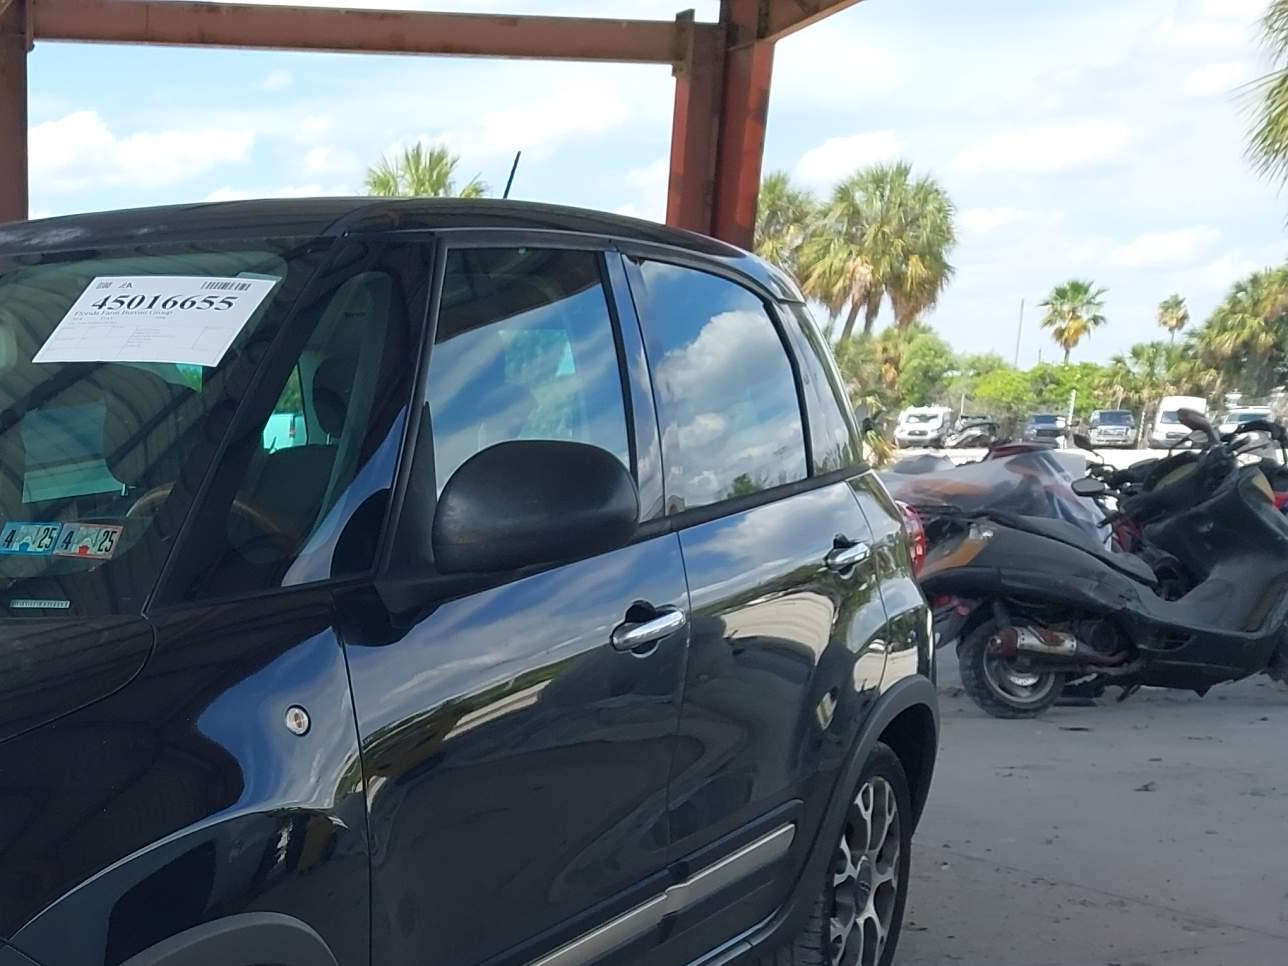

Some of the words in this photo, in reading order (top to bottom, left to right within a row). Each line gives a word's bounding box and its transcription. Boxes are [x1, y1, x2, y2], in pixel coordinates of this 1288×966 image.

[91, 294, 239, 311] 45016655
[2, 530, 16, 549] 4
[37, 527, 57, 549] 25
[62, 530, 75, 550] 4
[97, 530, 117, 552] 25
